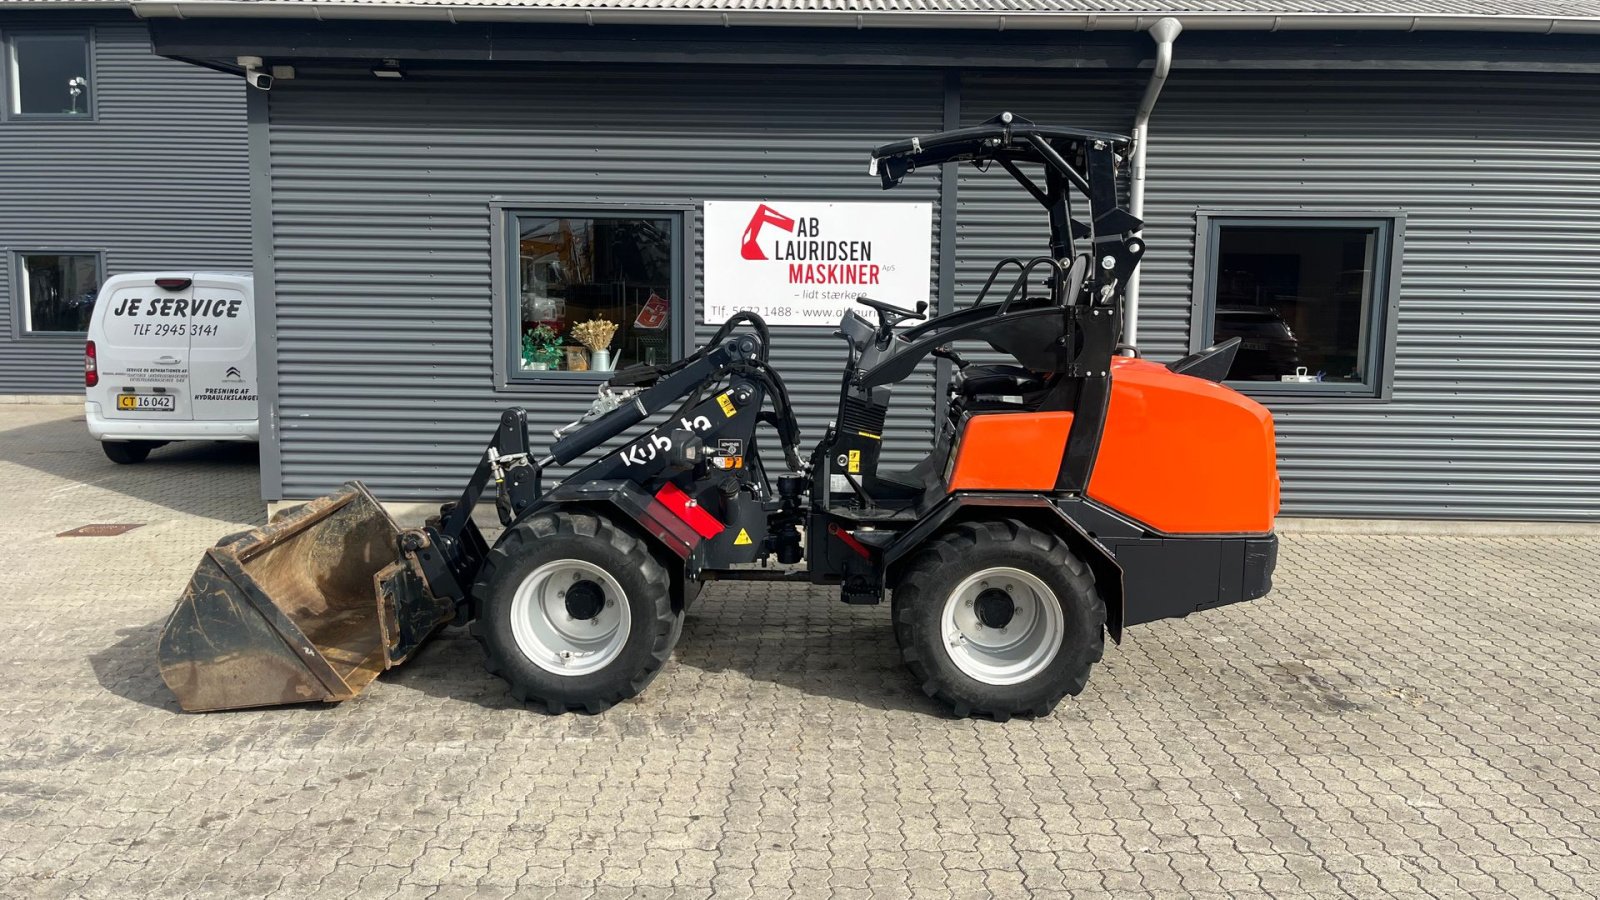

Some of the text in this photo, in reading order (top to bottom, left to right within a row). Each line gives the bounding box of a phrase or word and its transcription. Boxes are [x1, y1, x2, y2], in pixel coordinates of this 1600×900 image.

[797, 217, 820, 237] AB
[775, 240, 872, 261] LAURIDSEN
[788, 263, 896, 285] MASKINER ApS
[802, 289, 819, 300] lidt
[114, 298, 242, 318] JE SERVICE
[711, 305, 729, 318] Tlf.
[763, 306, 792, 317] 1488
[133, 323, 218, 337] TLF 2945 3141
[122, 397, 170, 407] CT 16 042
[619, 415, 712, 467] Kubta
